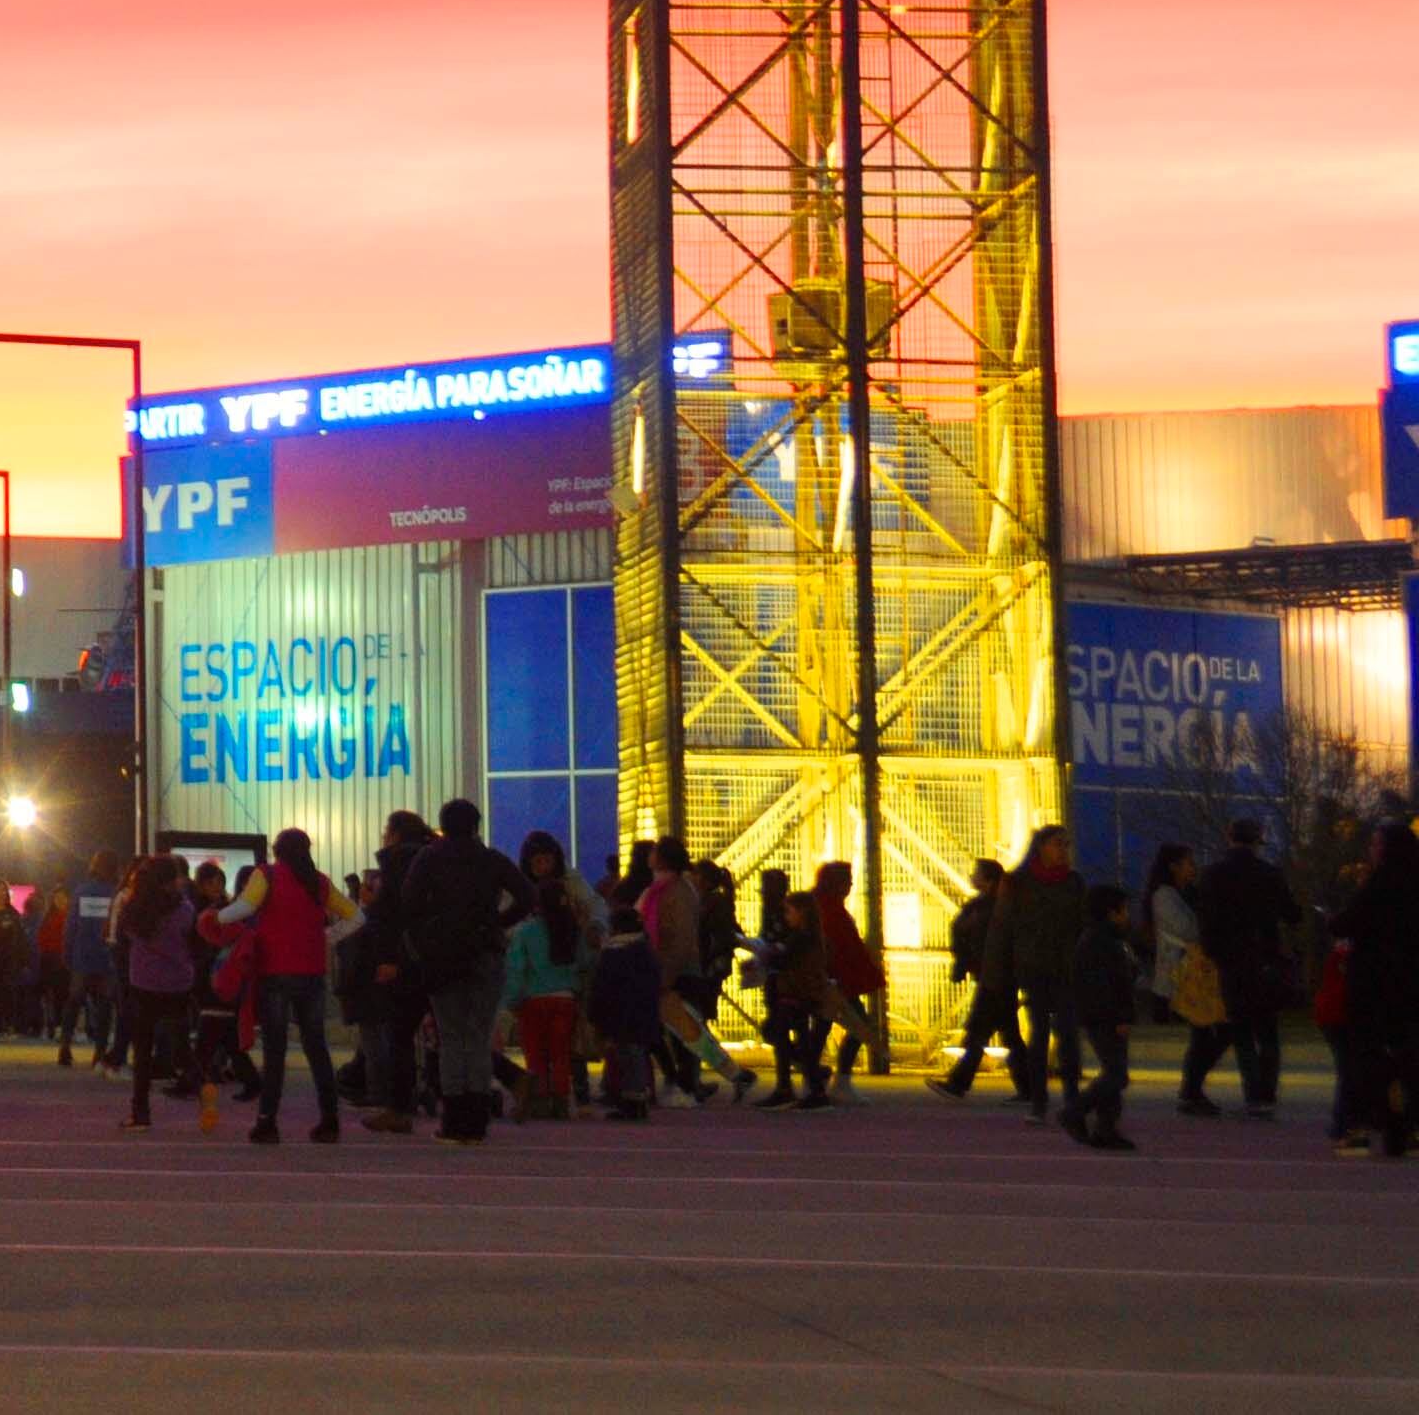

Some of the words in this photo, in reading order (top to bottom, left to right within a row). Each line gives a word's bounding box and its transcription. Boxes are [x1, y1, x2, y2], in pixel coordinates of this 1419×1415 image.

[219, 389, 309, 433] YPF
[320, 369, 435, 422] ENERGÍA
[435, 371, 509, 408] PARA
[506, 355, 604, 402] SOÑAR
[142, 477, 250, 533] YPF
[390, 505, 467, 528] TECNÓPOLIS
[180, 636, 358, 702] ESPACIO
[363, 633, 391, 660] DE
[1066, 644, 1208, 704] SPACIO
[1209, 656, 1233, 680] DE
[1236, 659, 1261, 682] LA
[180, 677, 411, 784] ENERGÍA
[1071, 690, 1262, 773] NERGÍA
